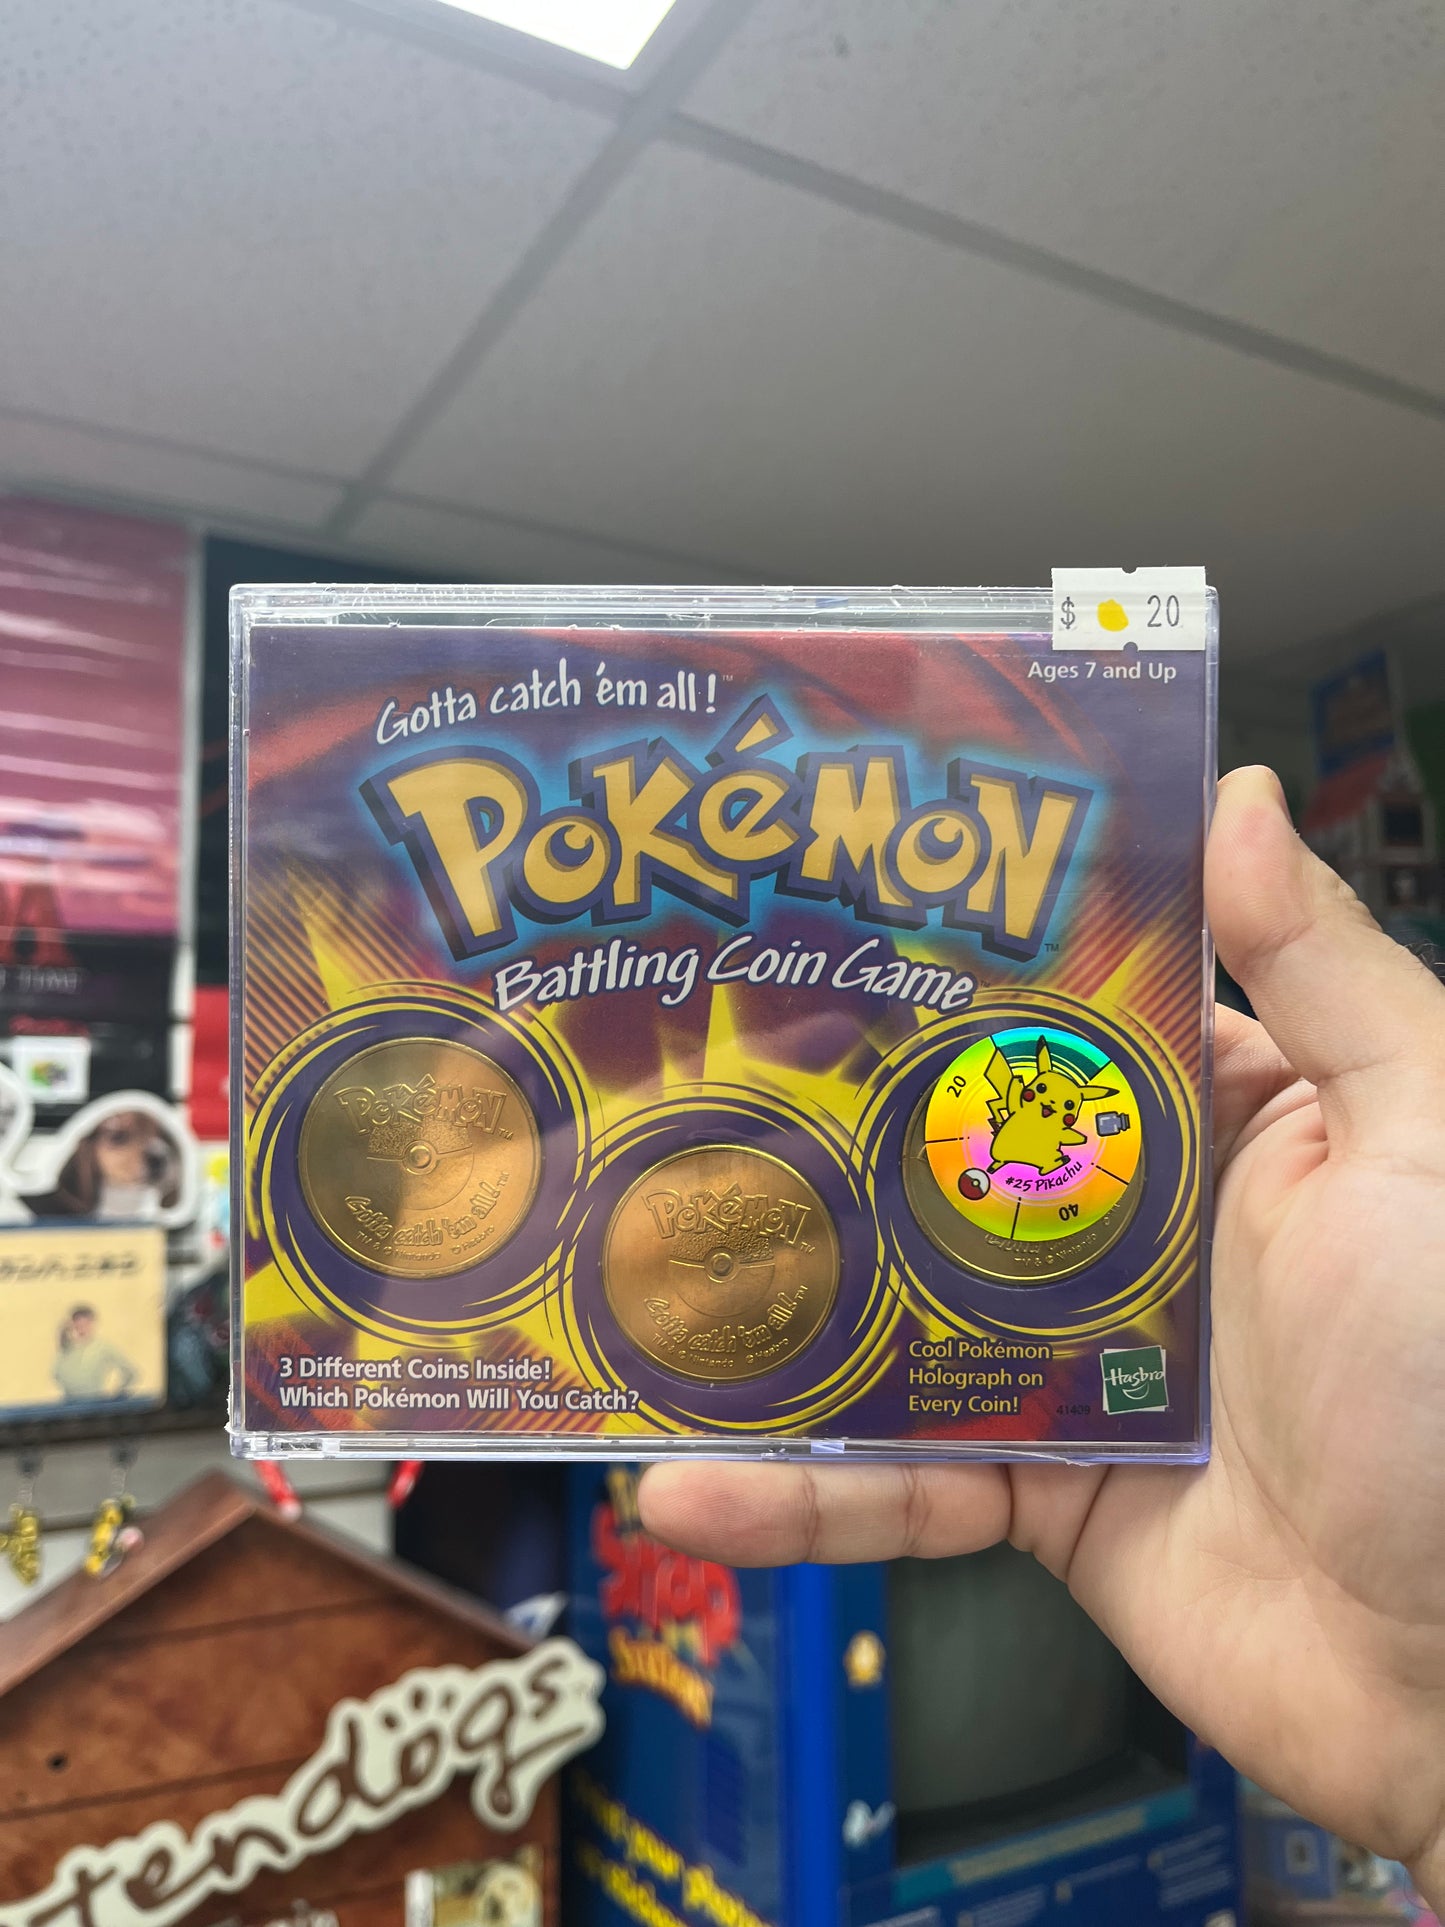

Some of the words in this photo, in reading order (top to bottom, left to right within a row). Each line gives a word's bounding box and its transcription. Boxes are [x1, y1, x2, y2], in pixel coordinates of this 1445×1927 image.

[1060, 596, 1075, 630] $
[1147, 594, 1180, 628] 20
[1027, 661, 1079, 683] Ages
[1085, 661, 1097, 679] 7
[1102, 661, 1141, 679] and
[1148, 662, 1177, 684] Up
[376, 686, 477, 745] Gotta
[489, 657, 581, 714] catch
[496, 939, 699, 1006] Battling
[708, 935, 822, 986] Coin
[831, 939, 974, 1010] Game
[947, 1075, 967, 1098] 20
[1006, 1176, 1033, 1192] #25
[1036, 1161, 1083, 1191] Pikachu
[345, 1196, 393, 1239] Gotta
[393, 1218, 443, 1246] catch
[1058, 1203, 1079, 1221] 40
[644, 1297, 689, 1344] Gotta
[688, 1325, 736, 1353] catch
[909, 1340, 952, 1358] Cool
[958, 1341, 1050, 1359] Pokémon
[280, 1358, 292, 1377] 3
[300, 1357, 402, 1379] Different
[407, 1358, 469, 1380] Coins
[476, 1358, 551, 1381] Inside!
[909, 1368, 1013, 1389] Holograph
[1018, 1372, 1043, 1386] on
[1104, 1367, 1165, 1388] Hasbro
[279, 1386, 348, 1408] Which
[355, 1387, 460, 1409] Pokémon
[466, 1387, 509, 1409] Will
[517, 1390, 558, 1410] You
[565, 1389, 639, 1411] Catch?
[908, 1396, 962, 1416] Every
[968, 1396, 1018, 1412] Coin!
